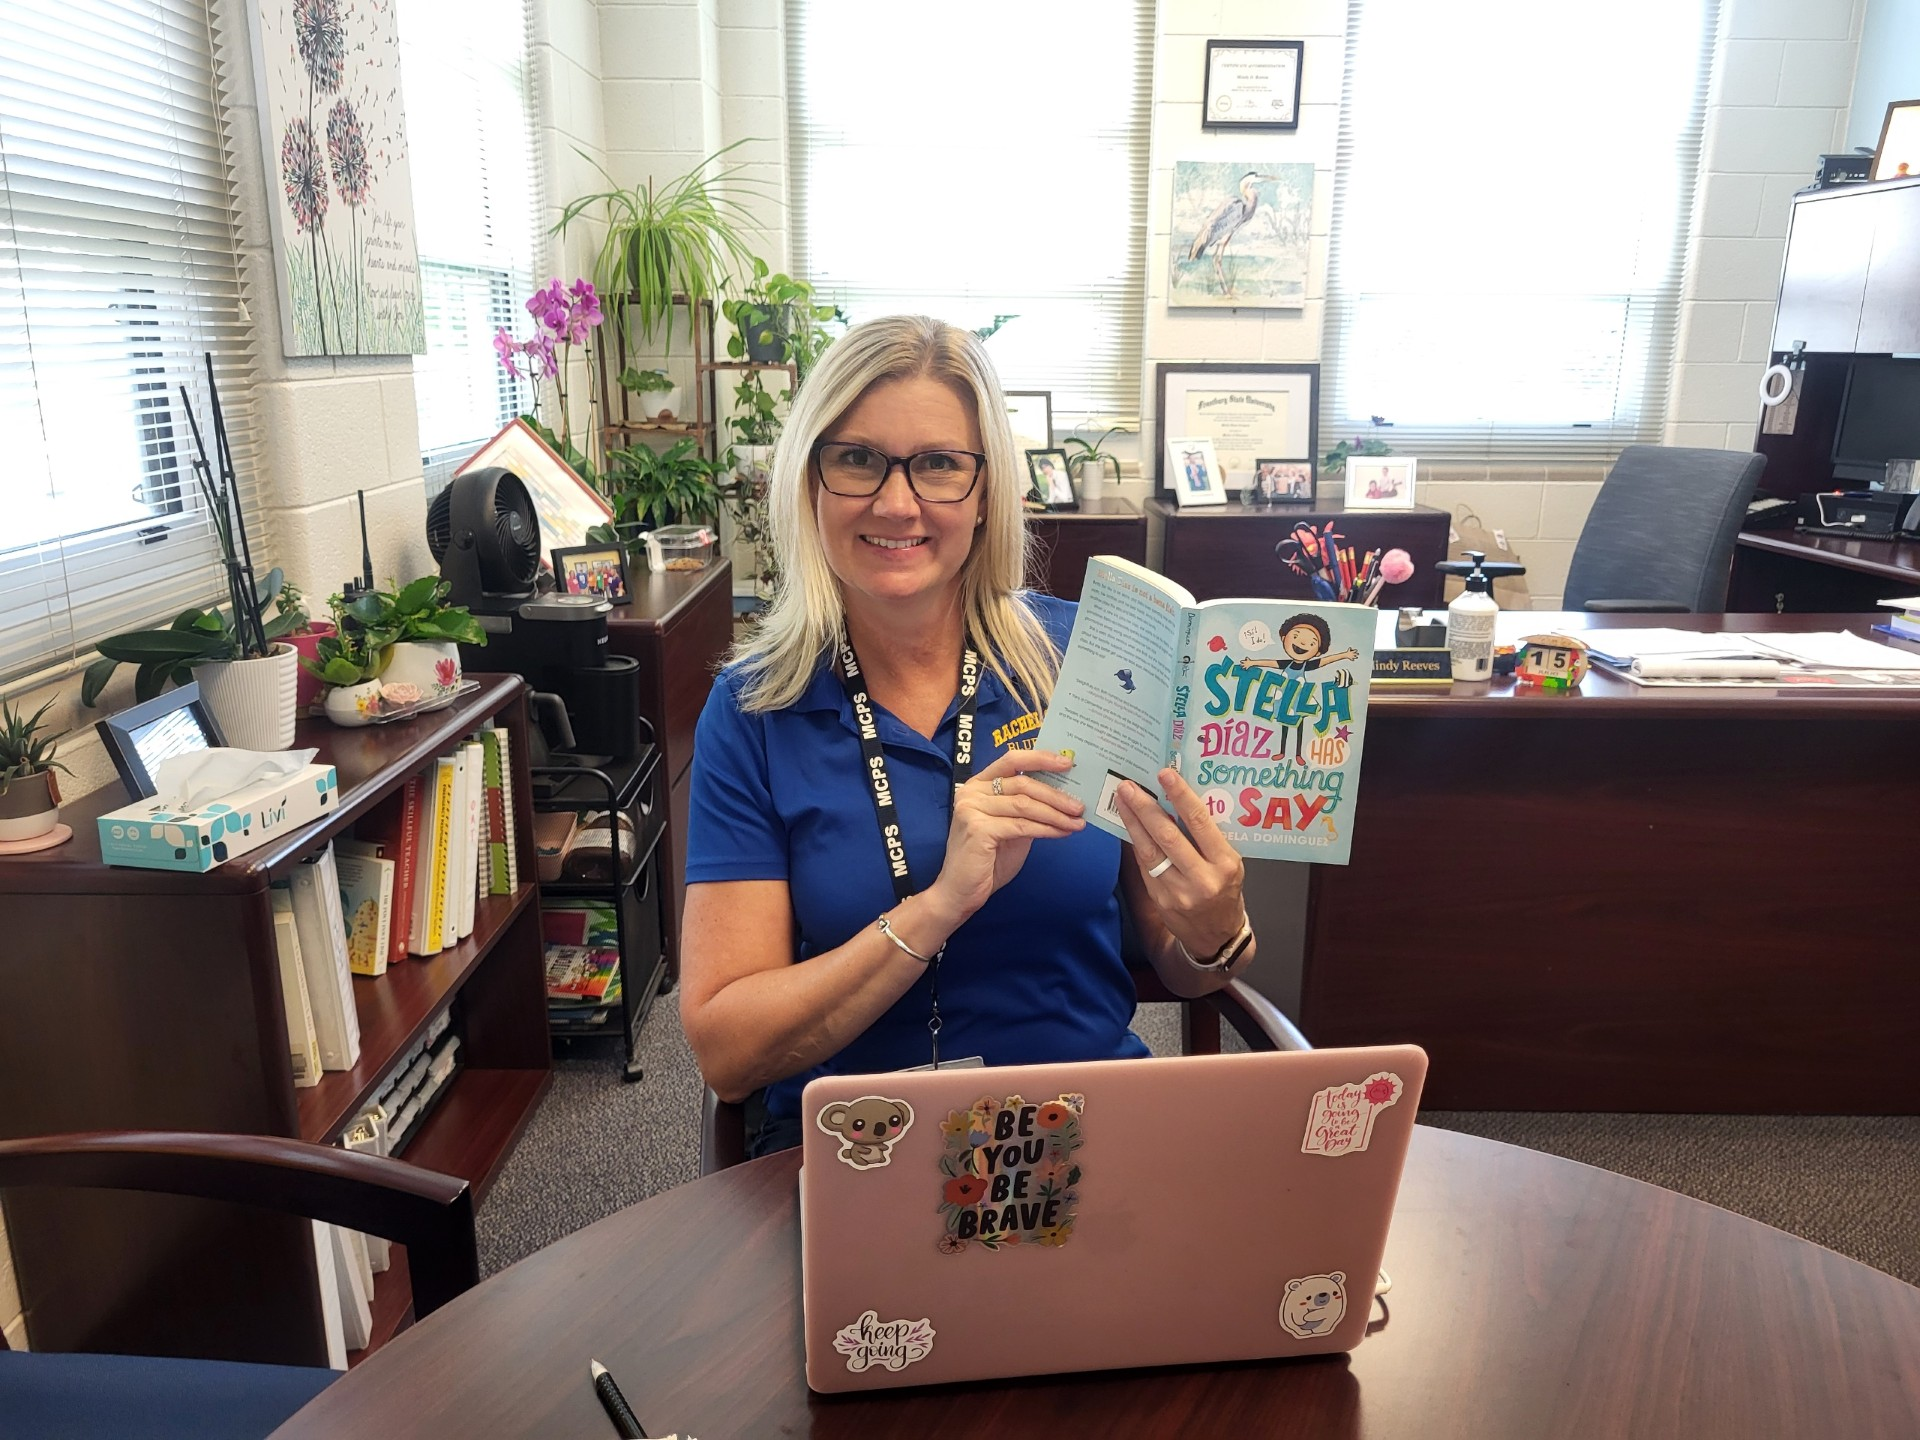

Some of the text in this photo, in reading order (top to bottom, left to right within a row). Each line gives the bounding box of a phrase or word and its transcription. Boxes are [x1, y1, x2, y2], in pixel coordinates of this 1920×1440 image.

[840, 640, 859, 678] MCP
[961, 649, 978, 697] MCPS
[1374, 659, 1440, 673] indy Reeves
[1175, 685, 1191, 718] STELLA
[1204, 655, 1352, 735] STELLA
[853, 692, 877, 739] MCPS
[956, 714, 973, 764] MCPS
[1311, 738, 1345, 766] HAS
[869, 756, 893, 807] MCPS
[1197, 759, 1345, 814] Something
[405, 800, 415, 843] SKILLFUL
[1206, 796, 1225, 816] to
[1237, 787, 1329, 832] SAY
[884, 824, 908, 877] MCPS
[1253, 833, 1329, 847] DOMINGUEZ
[403, 845, 411, 889] TEACHER
[994, 1106, 1037, 1141] BE
[1322, 1109, 1360, 1124] going
[1336, 1101, 1346, 1110] is
[1315, 1124, 1358, 1146] Great
[982, 1138, 1044, 1175] YOU
[990, 1170, 1032, 1203] BE
[958, 1199, 1060, 1239] BRAVE
[850, 1314, 910, 1346] keep
[852, 1342, 924, 1370] going
